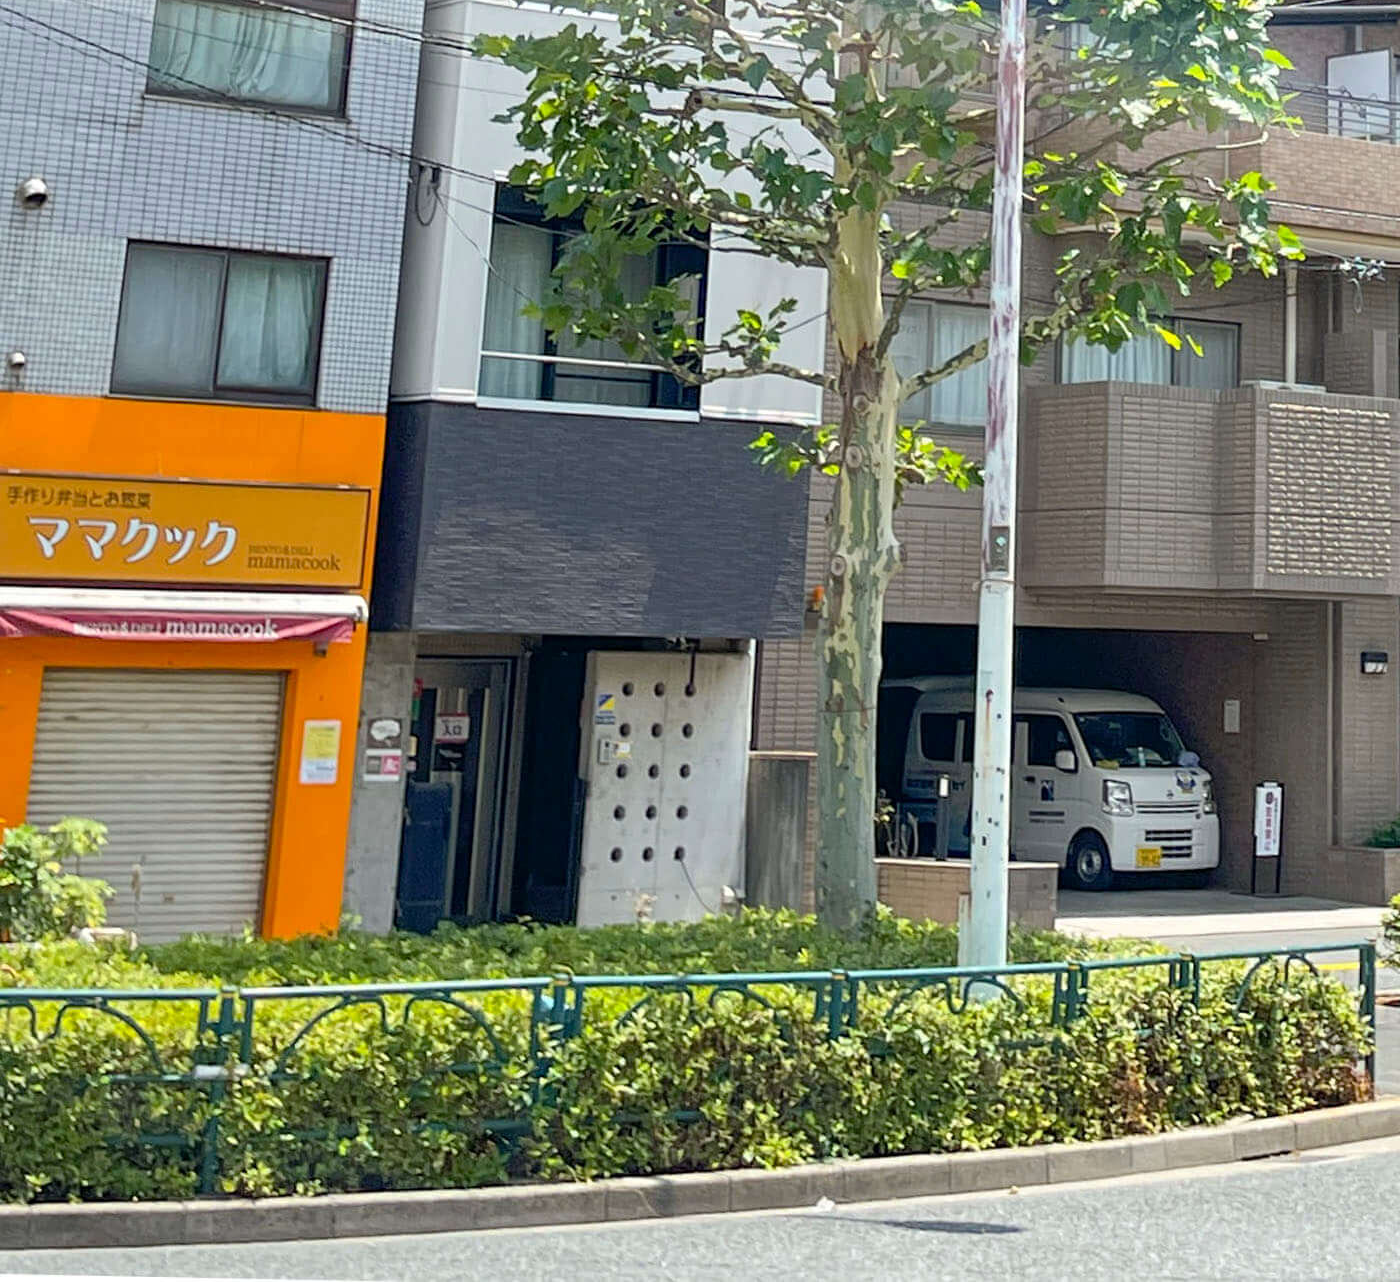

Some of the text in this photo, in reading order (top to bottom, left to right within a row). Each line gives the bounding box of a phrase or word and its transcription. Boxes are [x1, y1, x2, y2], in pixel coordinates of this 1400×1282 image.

[27, 515, 238, 566] ママクック
[247, 554, 341, 572] mamacook
[165, 616, 278, 637] mamacook
